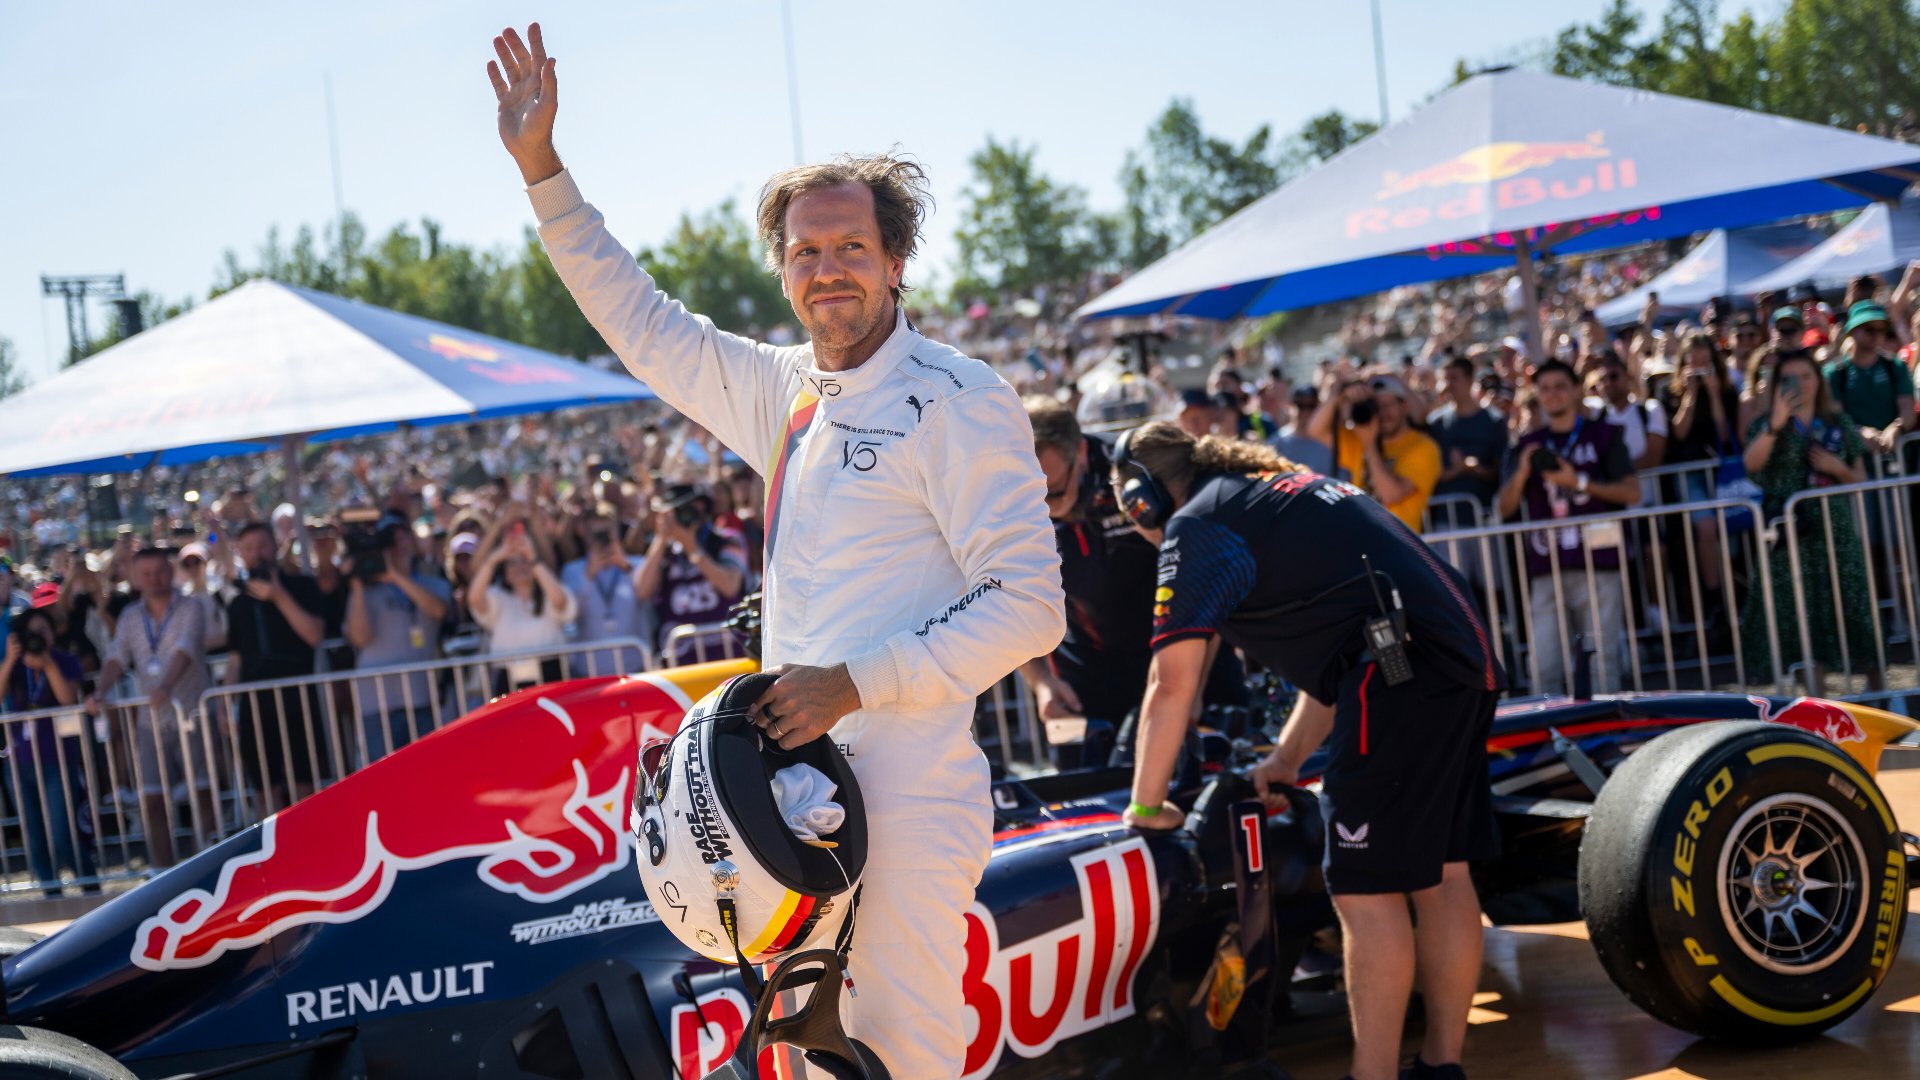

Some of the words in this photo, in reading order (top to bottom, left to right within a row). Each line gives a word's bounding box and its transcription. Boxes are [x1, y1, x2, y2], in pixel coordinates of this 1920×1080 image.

[1345, 186, 1484, 239] Red
[1497, 158, 1638, 209] Bull
[947, 371, 955, 379] TO
[830, 420, 850, 432] THERE
[687, 707, 705, 767] TRACE
[686, 811, 719, 864] RACE
[689, 767, 733, 861] WITHOUT
[1241, 813, 1263, 873] 1
[1669, 766, 1734, 918] ZERO
[511, 913, 607, 942] WITHOUT
[608, 905, 660, 925] TRAC
[570, 896, 627, 918] RACE
[1870, 848, 1905, 970] PIRELLI
[1683, 936, 1720, 966] P
[286, 960, 495, 1027] RENAULT
